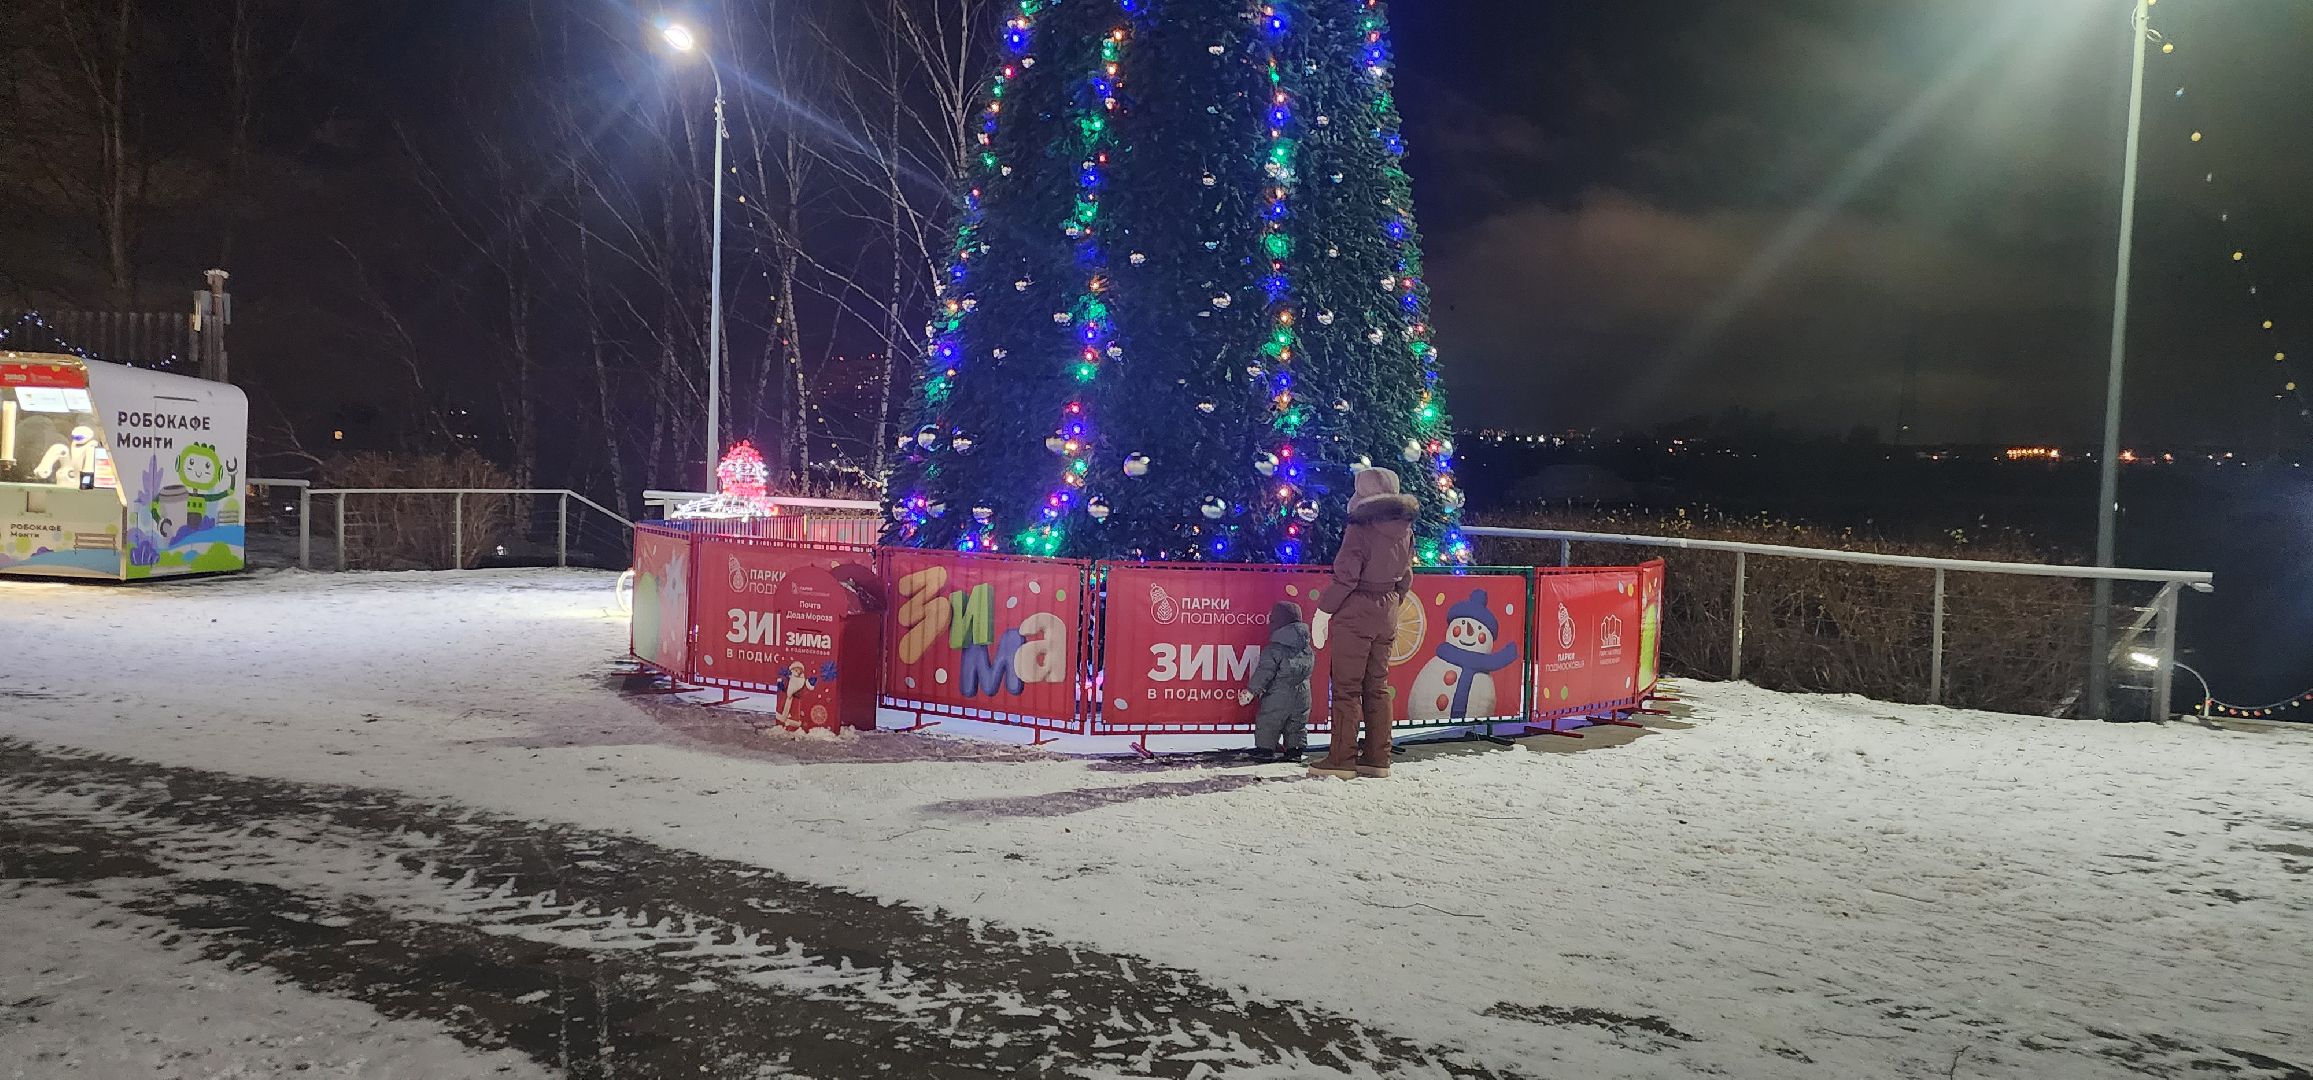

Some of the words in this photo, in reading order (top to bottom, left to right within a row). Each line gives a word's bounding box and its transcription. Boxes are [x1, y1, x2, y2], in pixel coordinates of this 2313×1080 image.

[117, 411, 211, 431] РОБОКАФЕ
[117, 432, 173, 449] Монти
[10, 523, 62, 531] РОБОКАФЕ
[750, 568, 786, 582] ПАРКИ
[799, 600, 821, 610] Почта
[1181, 597, 1230, 610] ПАРКИ
[726, 608, 781, 647] ЗИ
[726, 648, 734, 658] В
[1147, 689, 1157, 699] В
[1164, 689, 1242, 702] ПОДМОС
